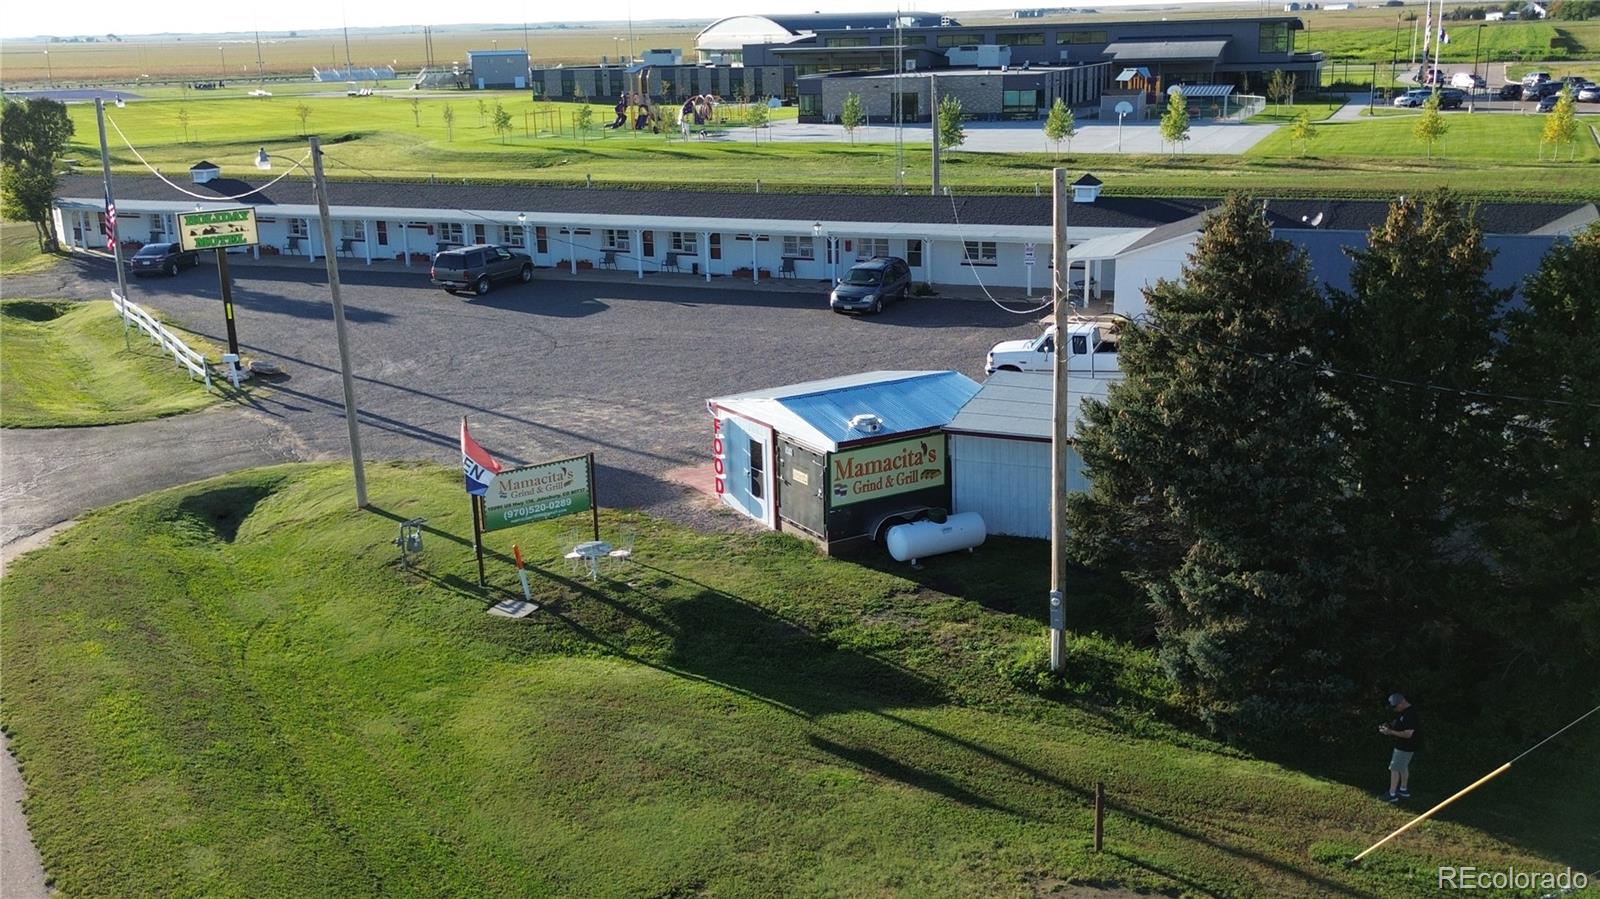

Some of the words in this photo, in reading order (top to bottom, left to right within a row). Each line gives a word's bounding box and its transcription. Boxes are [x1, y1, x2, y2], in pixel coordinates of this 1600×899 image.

[185, 211, 250, 226] HOLIDAY
[194, 234, 247, 248] MOTEL
[713, 418, 725, 494] FOOD
[834, 441, 937, 481] Mamacita's
[498, 466, 574, 491] Mamacita's
[511, 487, 535, 499] Grind
[536, 486, 545, 494] &
[545, 481, 563, 492] Grill
[853, 477, 884, 495] Grind
[885, 476, 894, 487] &
[896, 468, 919, 486] Grill
[504, 498, 572, 521] (970)520-0289
